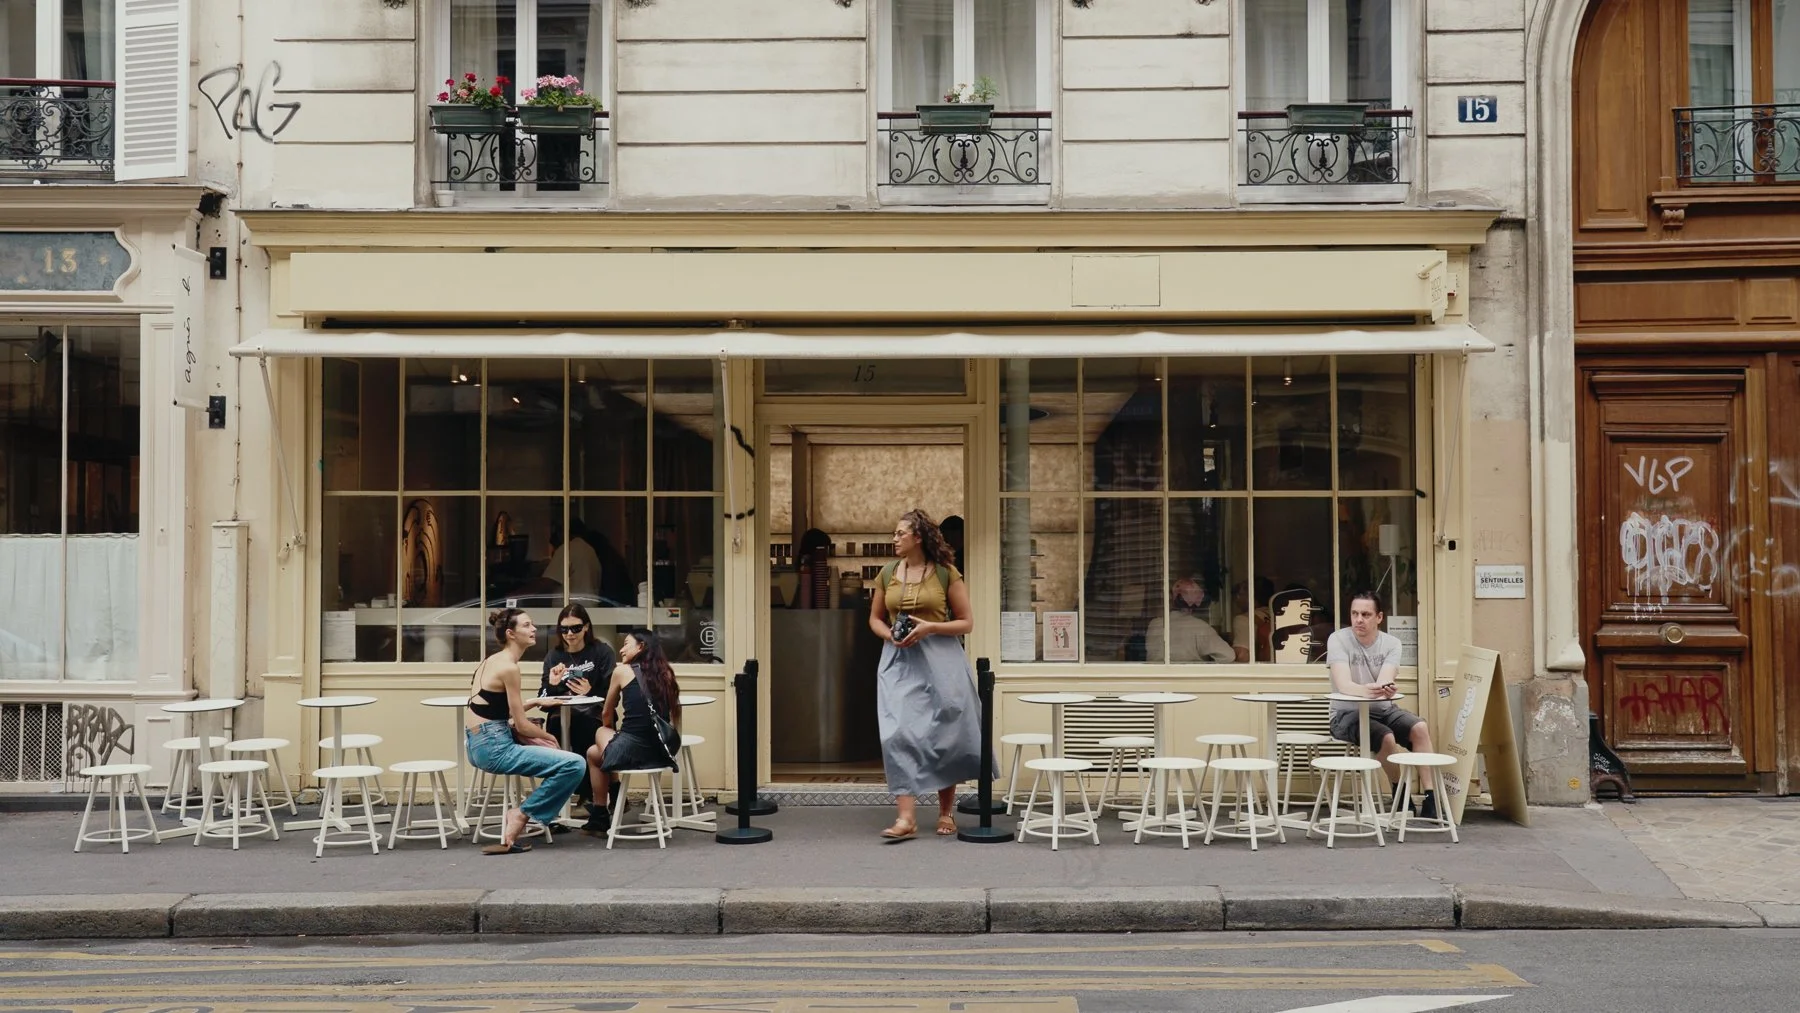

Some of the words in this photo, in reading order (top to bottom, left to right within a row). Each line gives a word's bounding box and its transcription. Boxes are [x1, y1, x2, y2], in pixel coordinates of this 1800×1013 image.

[1465, 97, 1490, 121] 15
[44, 247, 78, 274] 13
[855, 364, 876, 382] 15
